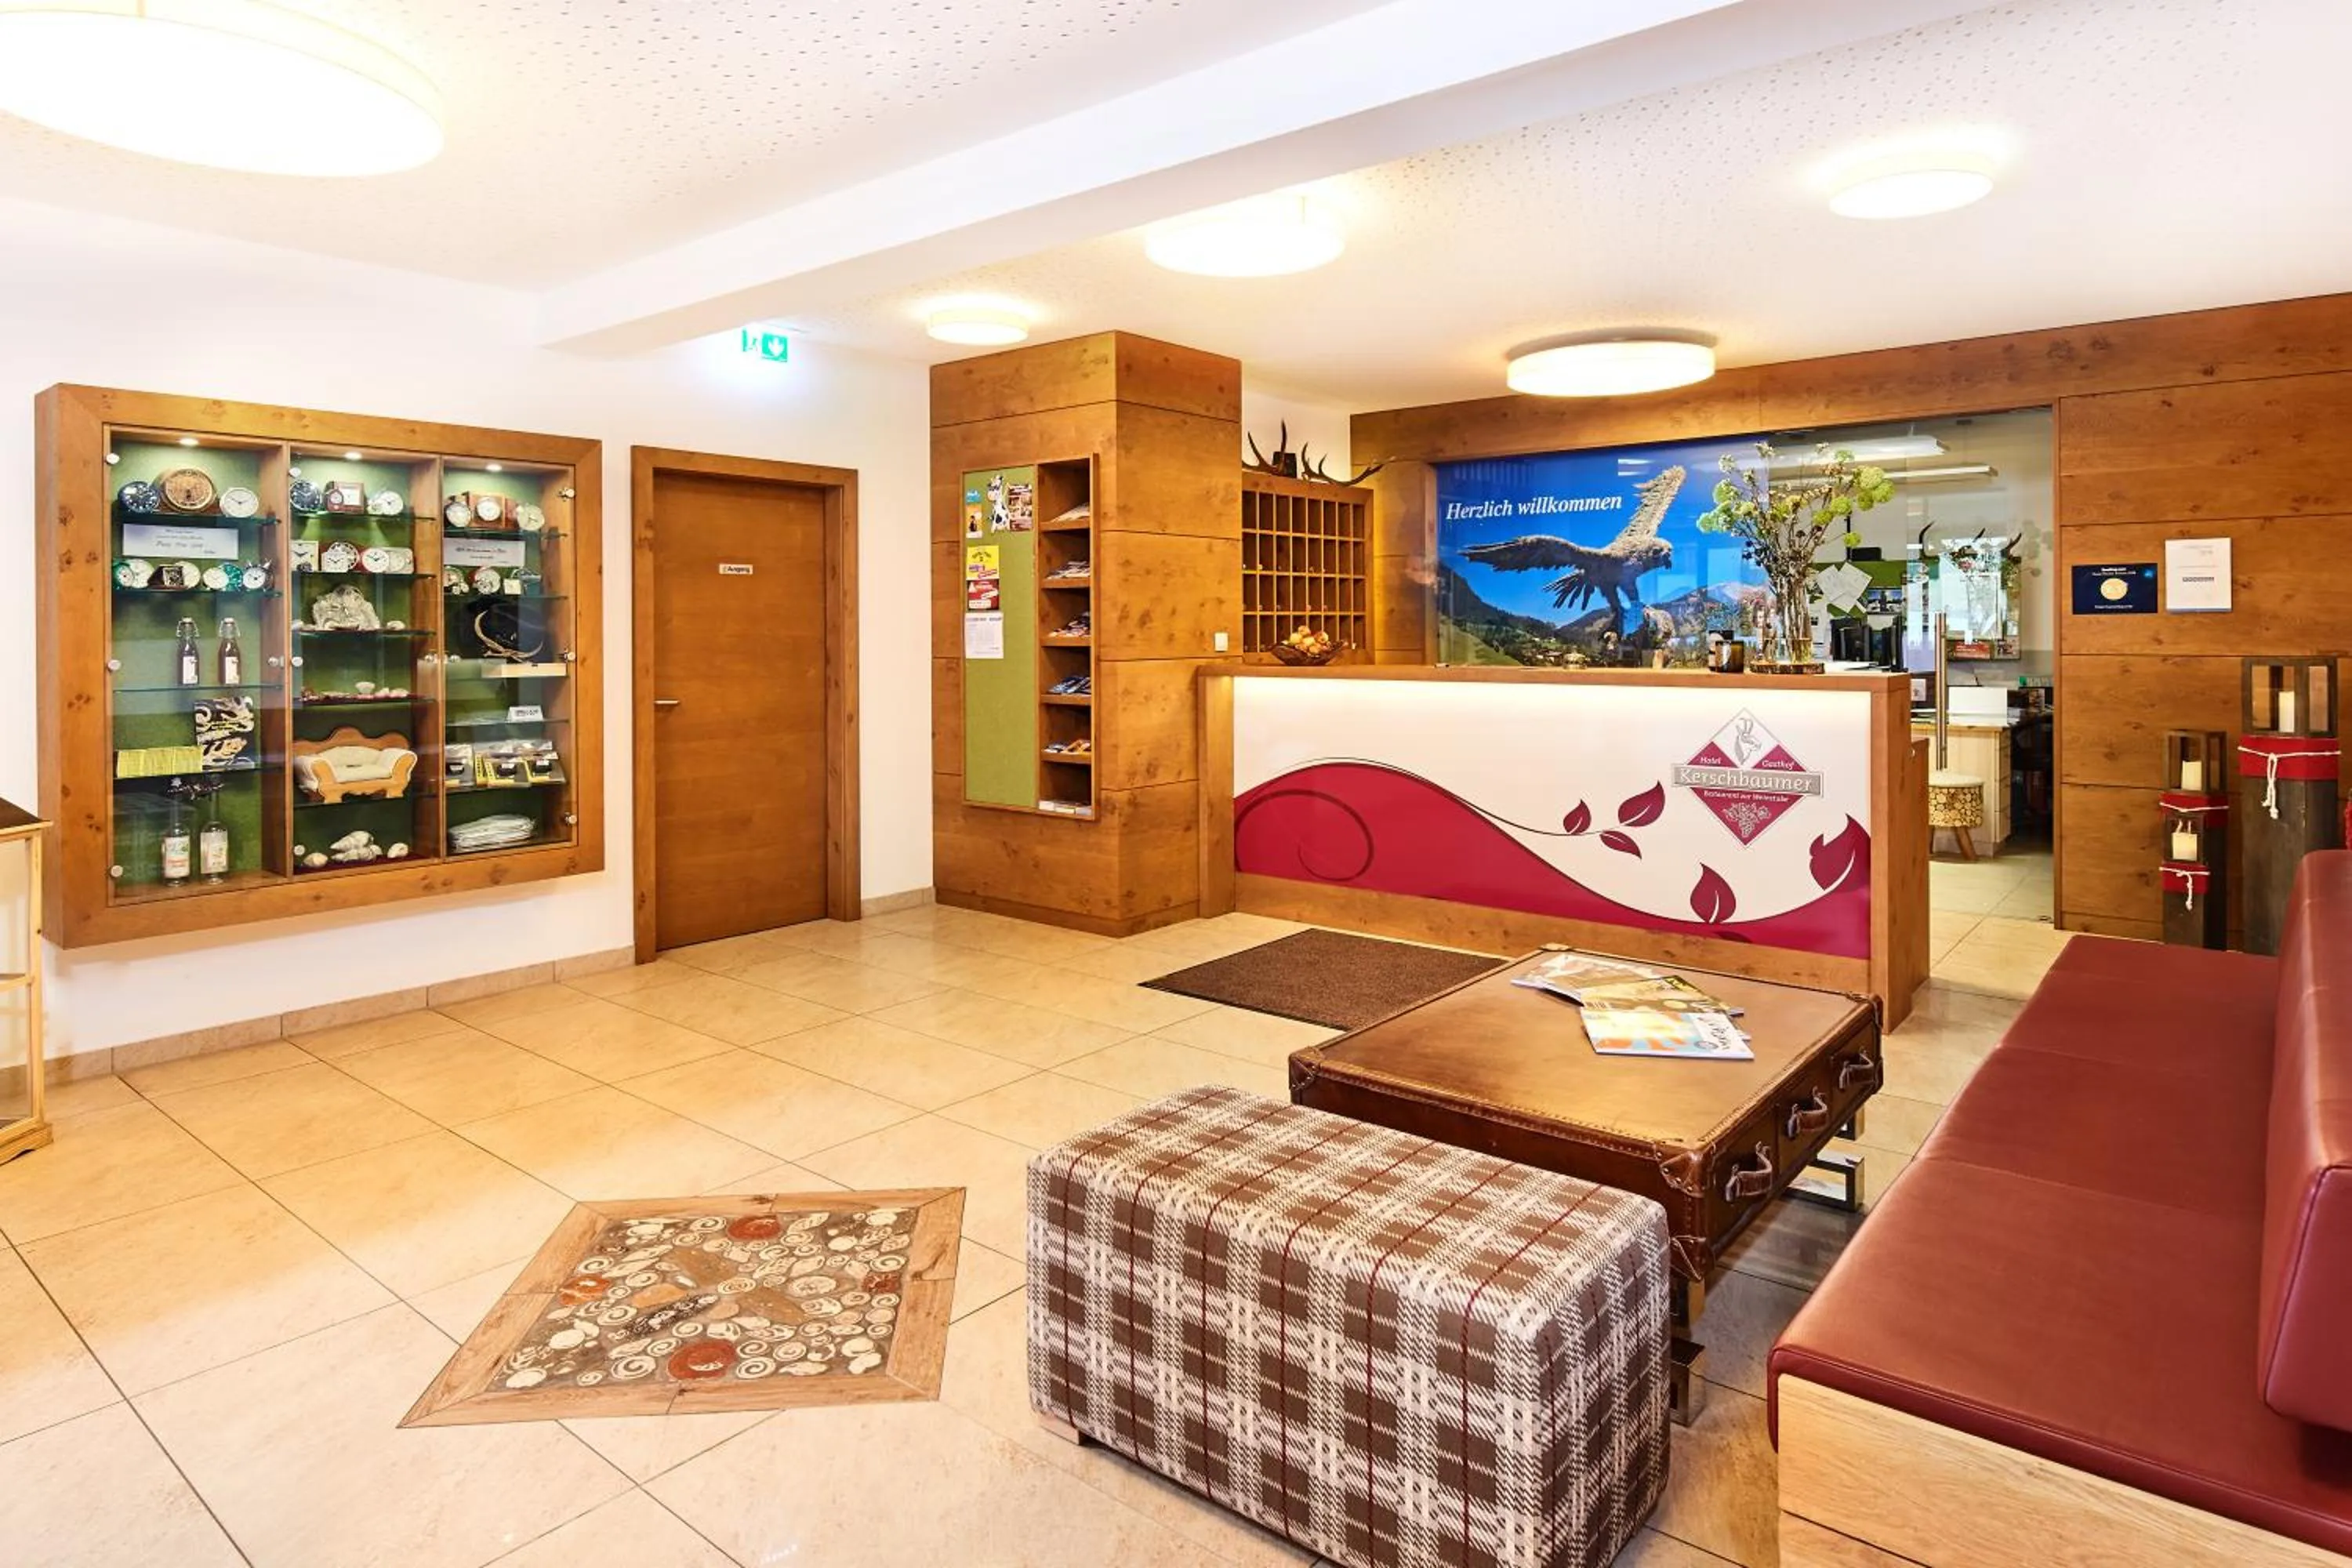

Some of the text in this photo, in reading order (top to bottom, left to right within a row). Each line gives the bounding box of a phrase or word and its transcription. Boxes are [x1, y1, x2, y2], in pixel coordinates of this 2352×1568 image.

[1446, 495, 1622, 520] Herzlich willkommen
[1680, 768, 1812, 792] Kerschbaumer
